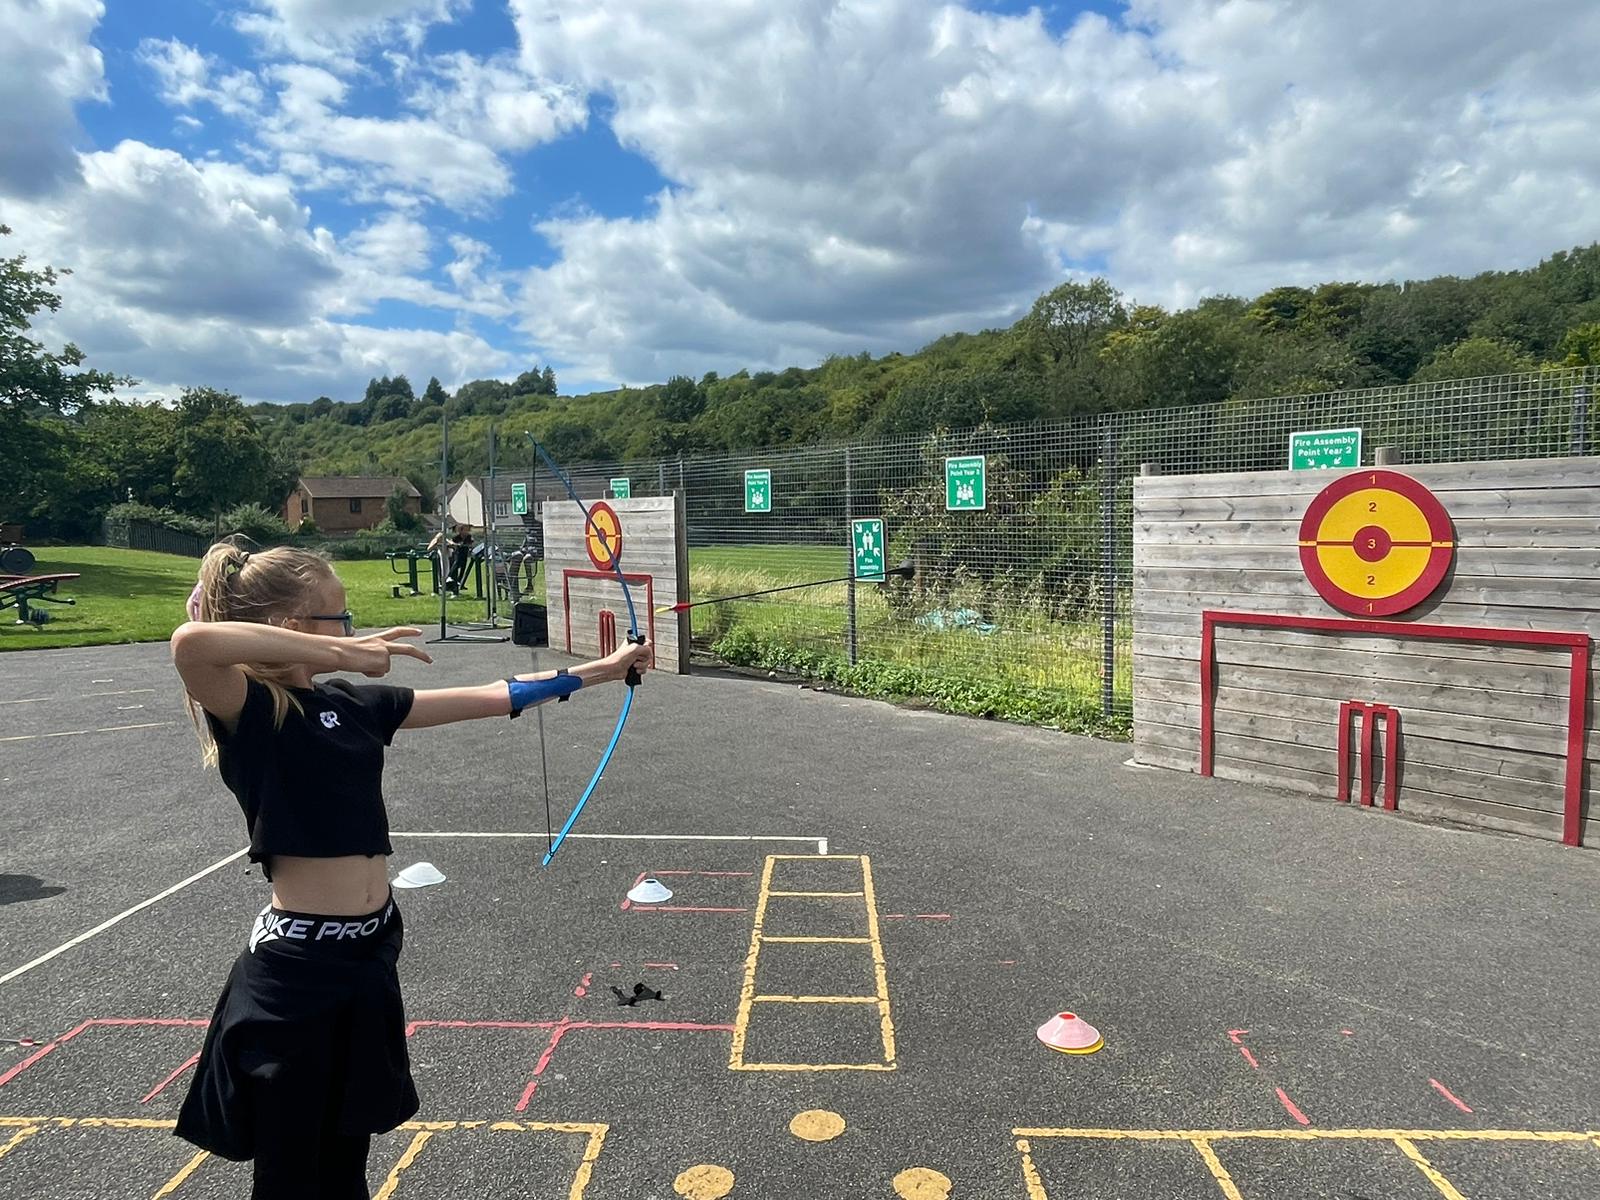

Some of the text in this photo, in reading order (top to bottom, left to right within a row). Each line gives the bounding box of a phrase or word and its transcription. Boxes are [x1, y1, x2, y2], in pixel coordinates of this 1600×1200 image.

[1294, 436, 1357, 447] Fire Assembly
[1298, 446, 1352, 457] Point Year 2
[1369, 475, 1376, 484] 1
[1369, 502, 1377, 512] 2
[1367, 539, 1376, 549] 3
[1367, 575, 1376, 586] 2
[1368, 603, 1373, 613] 1
[315, 917, 380, 941] PRO
